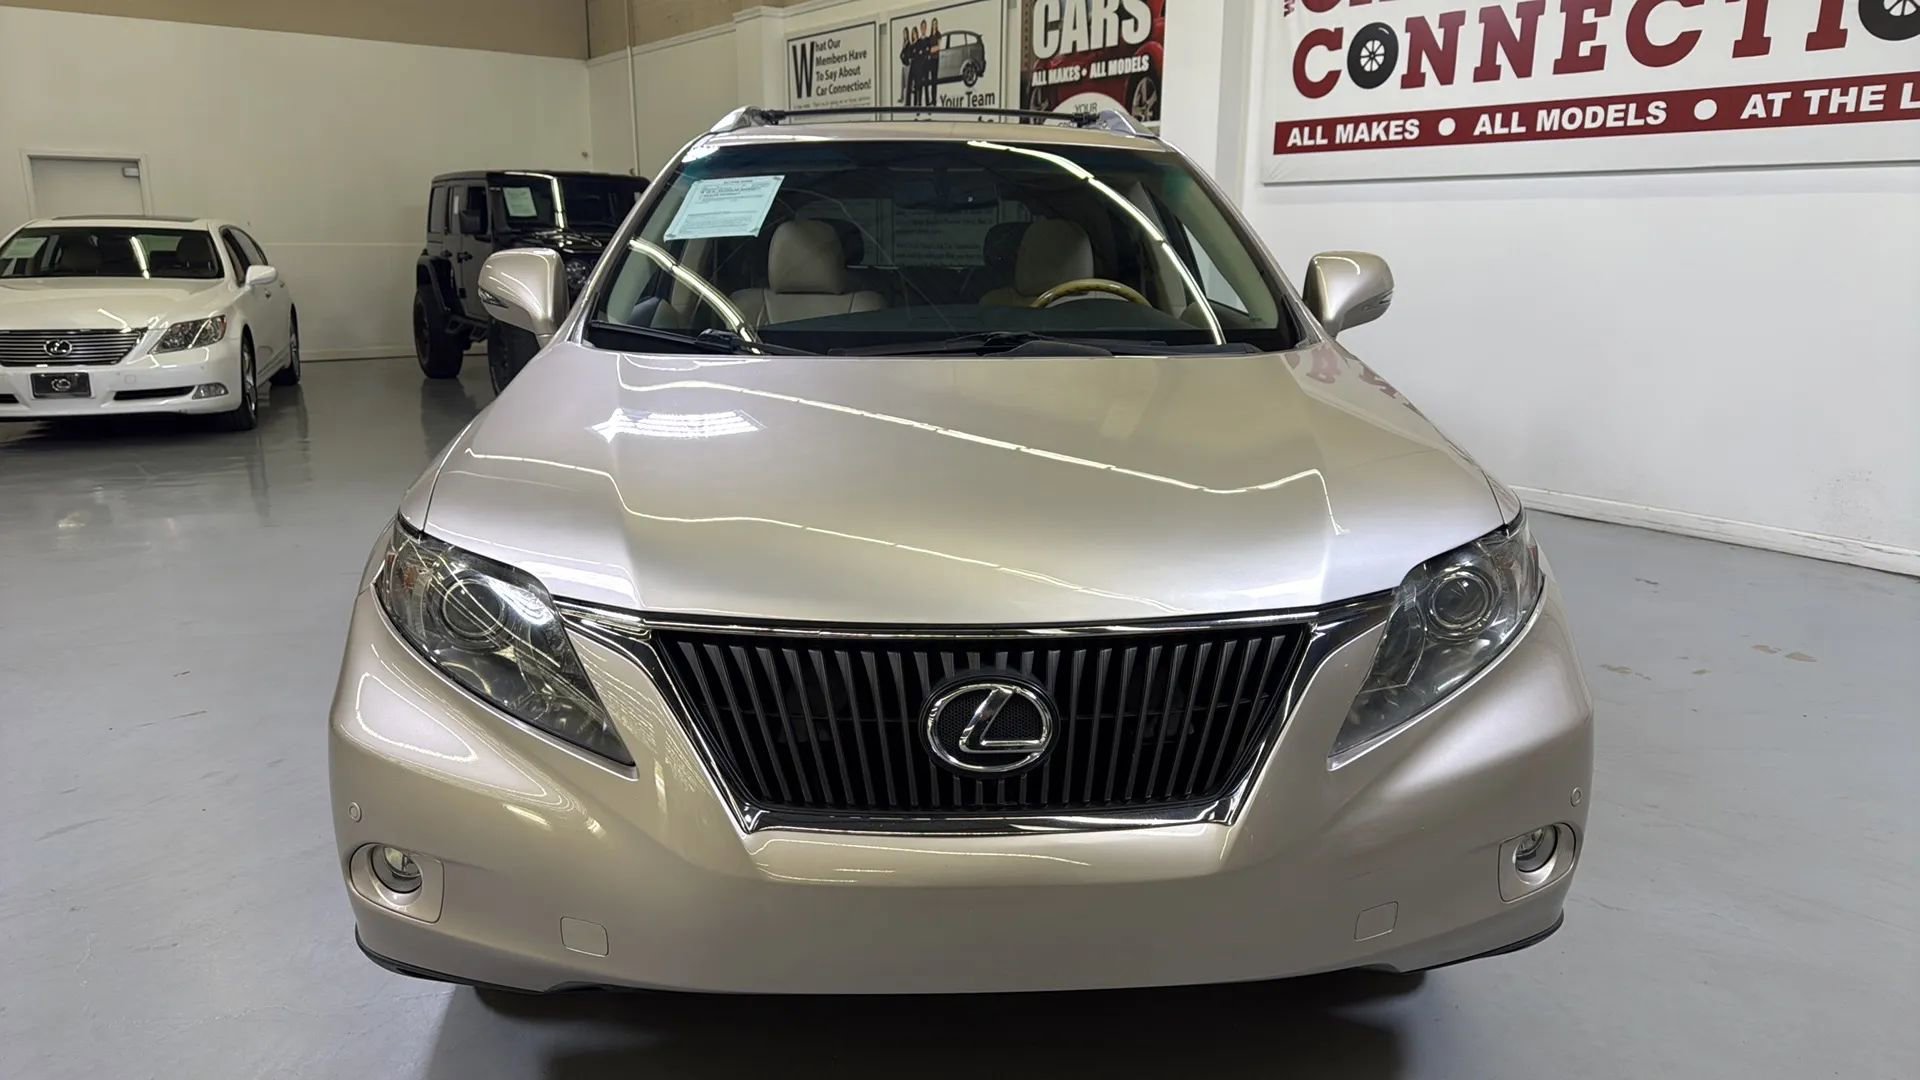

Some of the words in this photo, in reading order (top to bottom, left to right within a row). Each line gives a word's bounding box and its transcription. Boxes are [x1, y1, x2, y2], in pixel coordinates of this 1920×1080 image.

[1033, 0, 1151, 58] CARS
[827, 38, 841, 50] Our
[815, 53, 848, 66] Members
[849, 50, 867, 61] Have
[816, 71, 825, 82] To
[825, 69, 838, 82] Say
[839, 65, 861, 78] About
[1031, 71, 1047, 86] ALL
[1049, 65, 1081, 83] MAKES
[1089, 60, 1107, 79] ALL
[1108, 55, 1149, 75] MODELS
[816, 86, 828, 96] Car
[828, 78, 872, 95] Connection!
[940, 93, 964, 108] Your
[965, 90, 996, 108] Team
[1286, 126, 1328, 148] ALL
[1335, 118, 1420, 143] MAKES
[1473, 110, 1527, 136] ALL
[1536, 100, 1668, 132] MODELS
[1740, 91, 1792, 120] AT
[1803, 84, 1888, 116] THE
